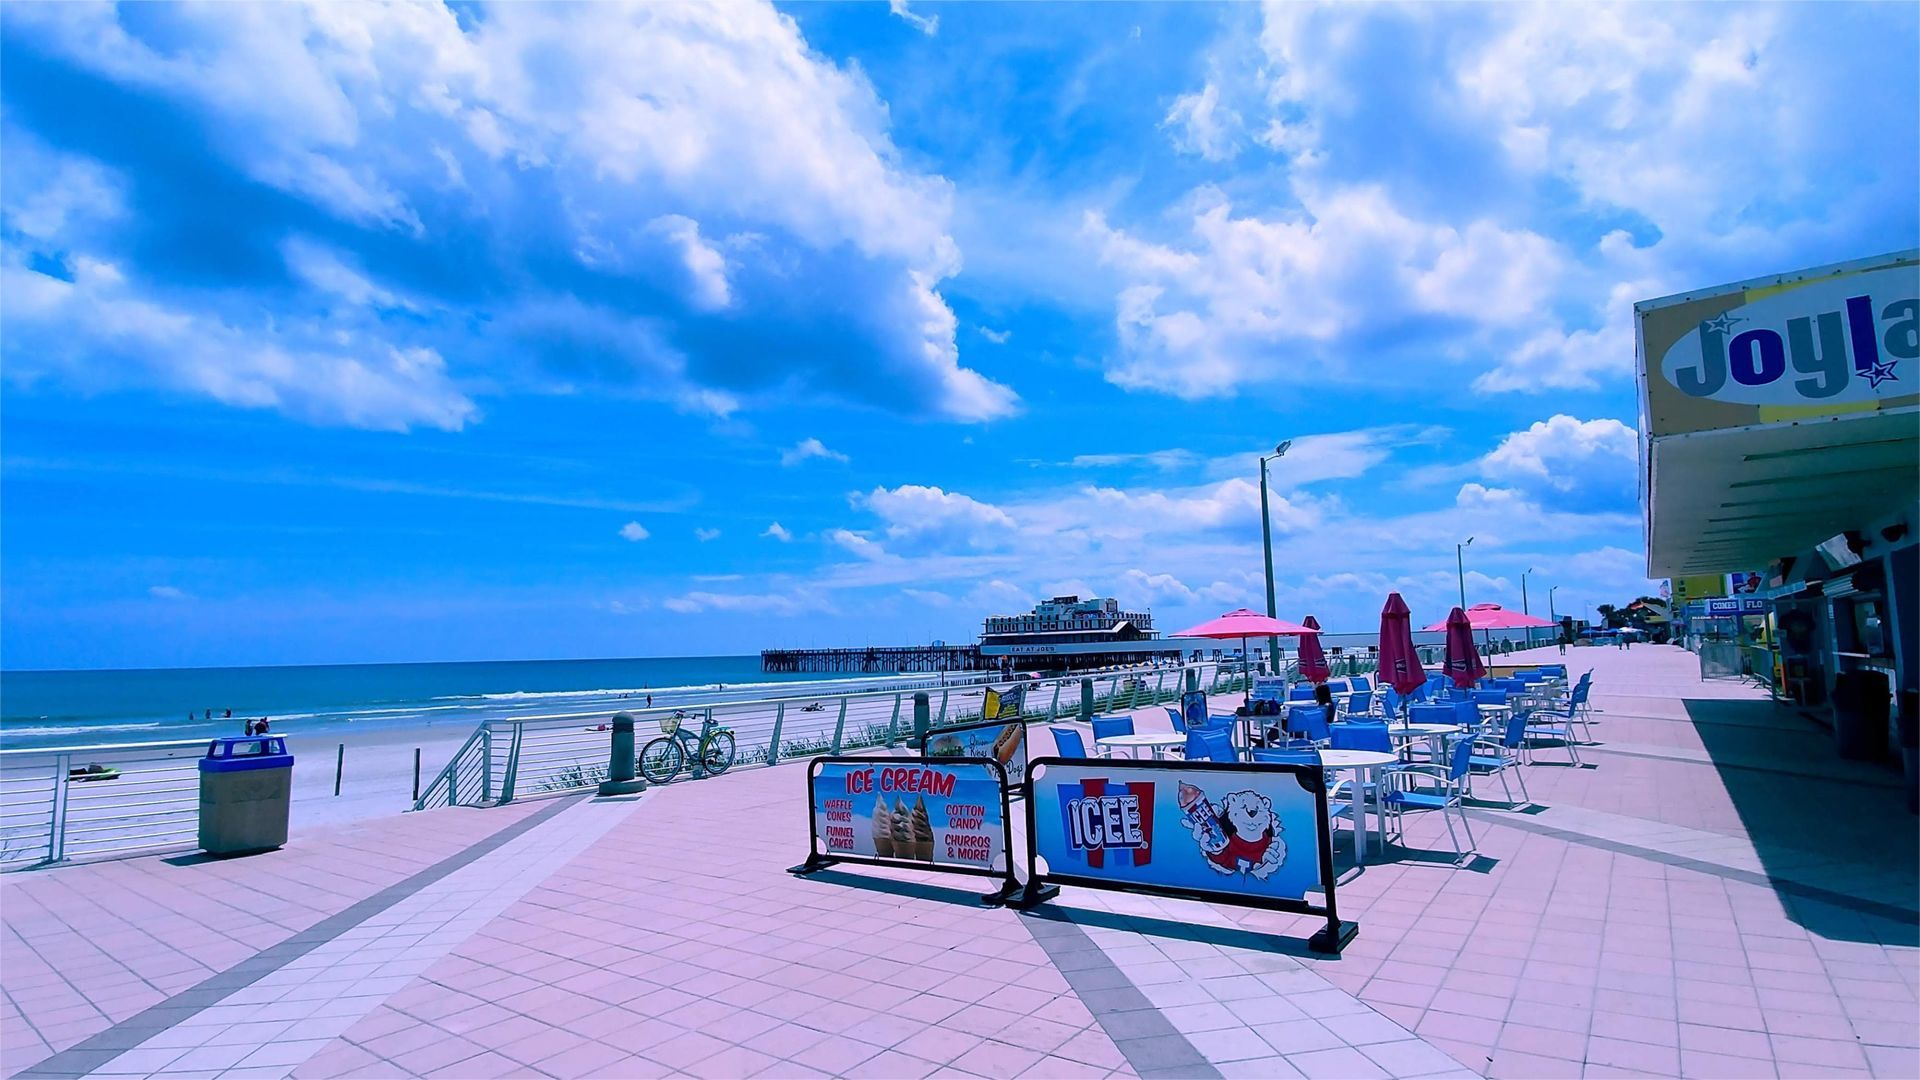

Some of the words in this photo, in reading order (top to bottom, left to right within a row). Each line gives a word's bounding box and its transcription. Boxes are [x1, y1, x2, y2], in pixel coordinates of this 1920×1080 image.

[1006, 760, 1023, 777] Dogs
[846, 769, 875, 794] ICE
[881, 768, 956, 797] CREAM
[824, 800, 853, 811] WAFFLE
[945, 804, 985, 816] COTTON
[1188, 801, 1214, 824] ICEE
[826, 811, 852, 822] CONES
[1067, 796, 1144, 850] ICEE
[825, 825, 854, 837] FUNNEL
[949, 817, 982, 831] CANDY
[828, 837, 854, 850] CAKES
[944, 833, 991, 848] CHURROS
[947, 847, 955, 857] &
[957, 848, 990, 861] MORE!
